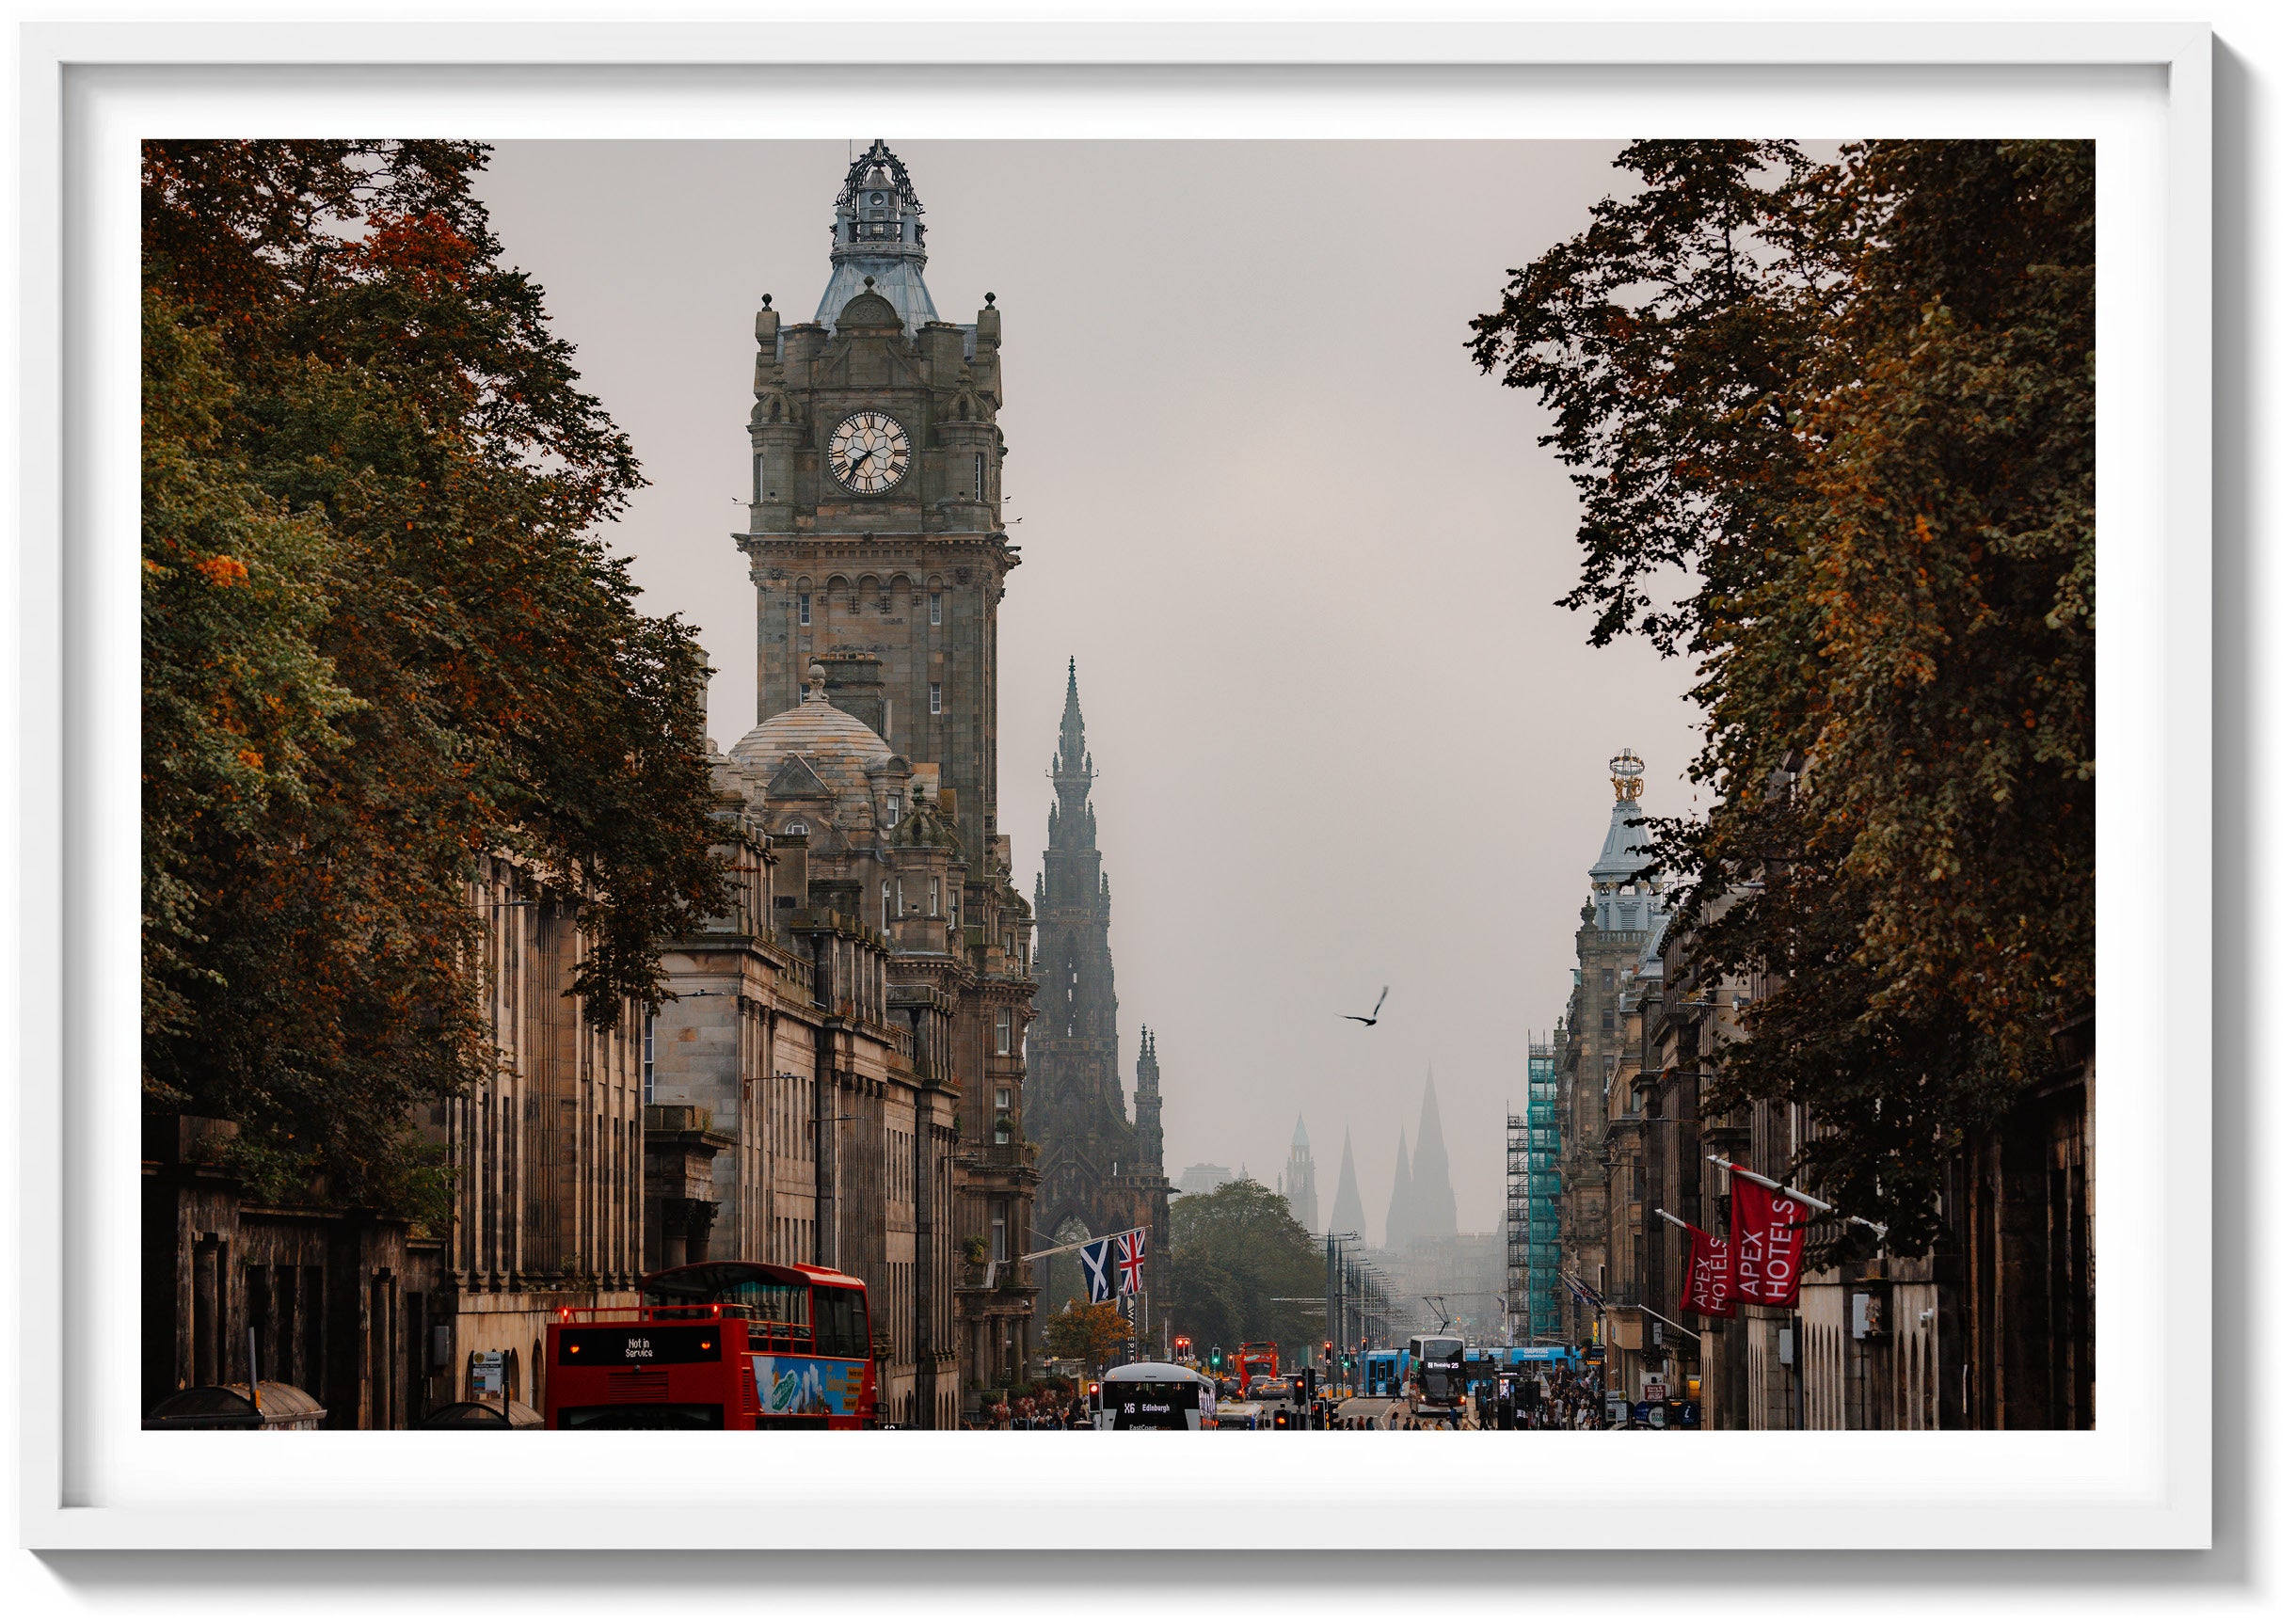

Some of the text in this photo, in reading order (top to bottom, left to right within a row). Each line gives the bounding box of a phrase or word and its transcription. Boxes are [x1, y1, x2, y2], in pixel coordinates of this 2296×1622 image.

[1738, 1229, 1763, 1296] APEX
[1765, 1200, 1795, 1298] HOTELS
[1692, 1257, 1711, 1308] APEX
[625, 1348, 653, 1358] Service
[628, 1338, 650, 1348] Not in
[1124, 1402, 1171, 1414] X6 Edinburgh
